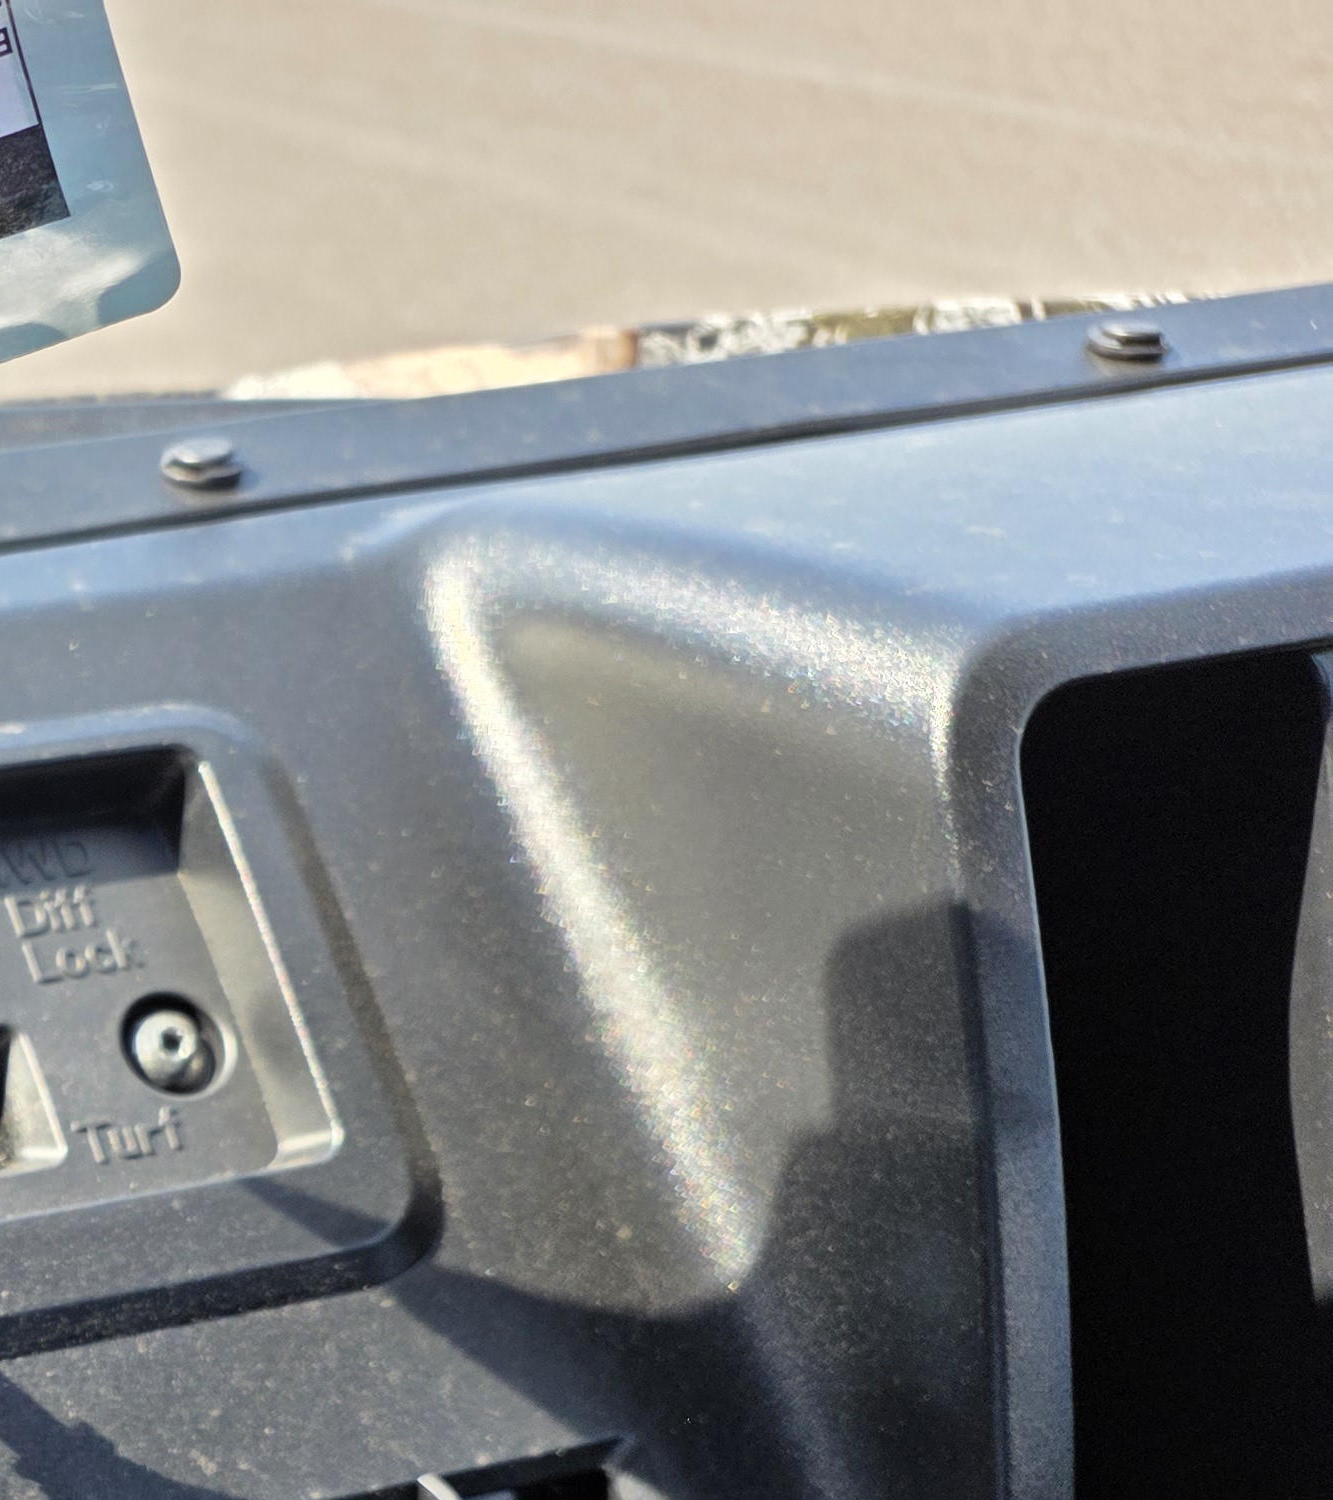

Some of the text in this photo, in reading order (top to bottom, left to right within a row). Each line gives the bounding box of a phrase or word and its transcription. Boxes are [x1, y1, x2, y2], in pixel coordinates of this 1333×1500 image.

[5, 886, 97, 940] Diff
[21, 932, 145, 985] Lock
[71, 1108, 186, 1166] Turf
